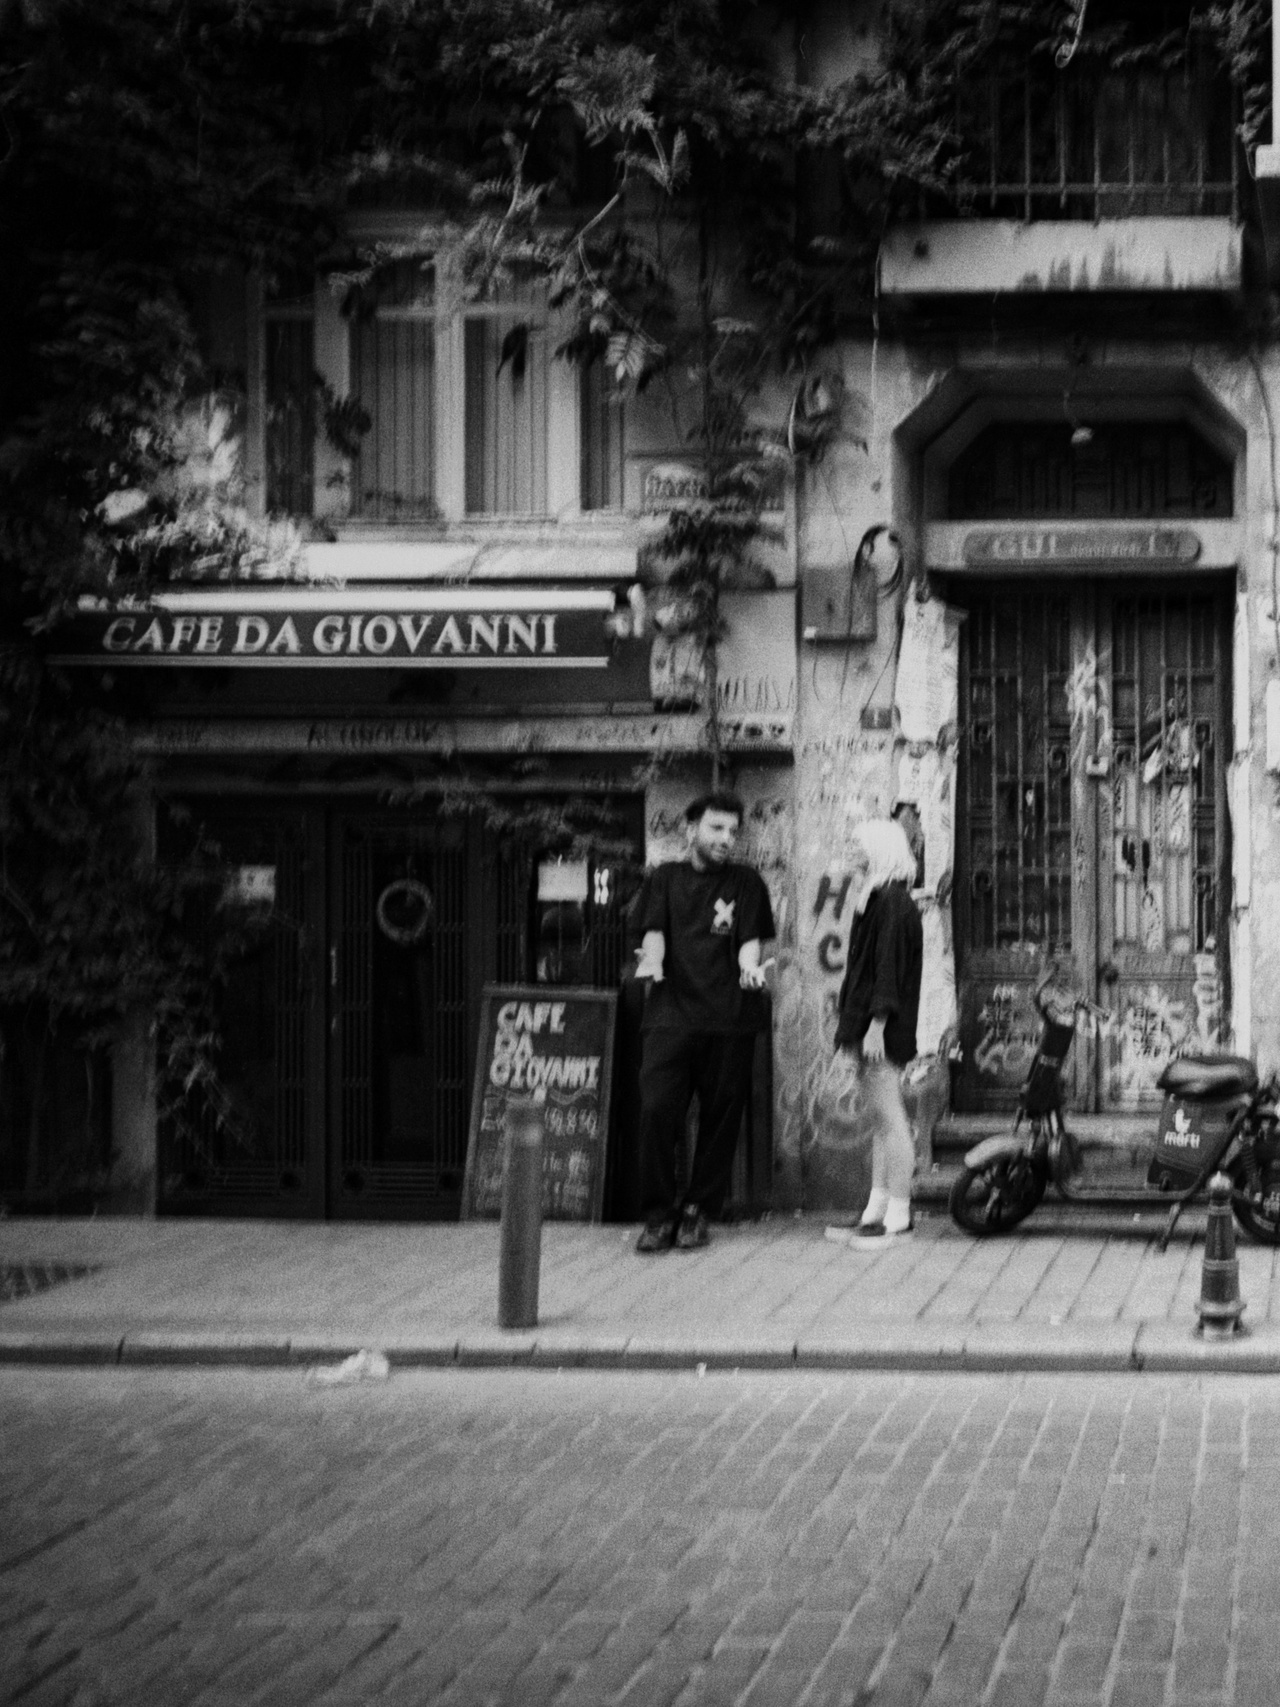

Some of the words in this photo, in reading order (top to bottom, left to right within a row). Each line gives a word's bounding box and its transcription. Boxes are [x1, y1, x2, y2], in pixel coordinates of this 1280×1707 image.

[102, 614, 224, 654] CAFE
[232, 614, 301, 654] DA
[312, 614, 558, 654] GIOVANNI
[497, 1001, 566, 1034] CAFE
